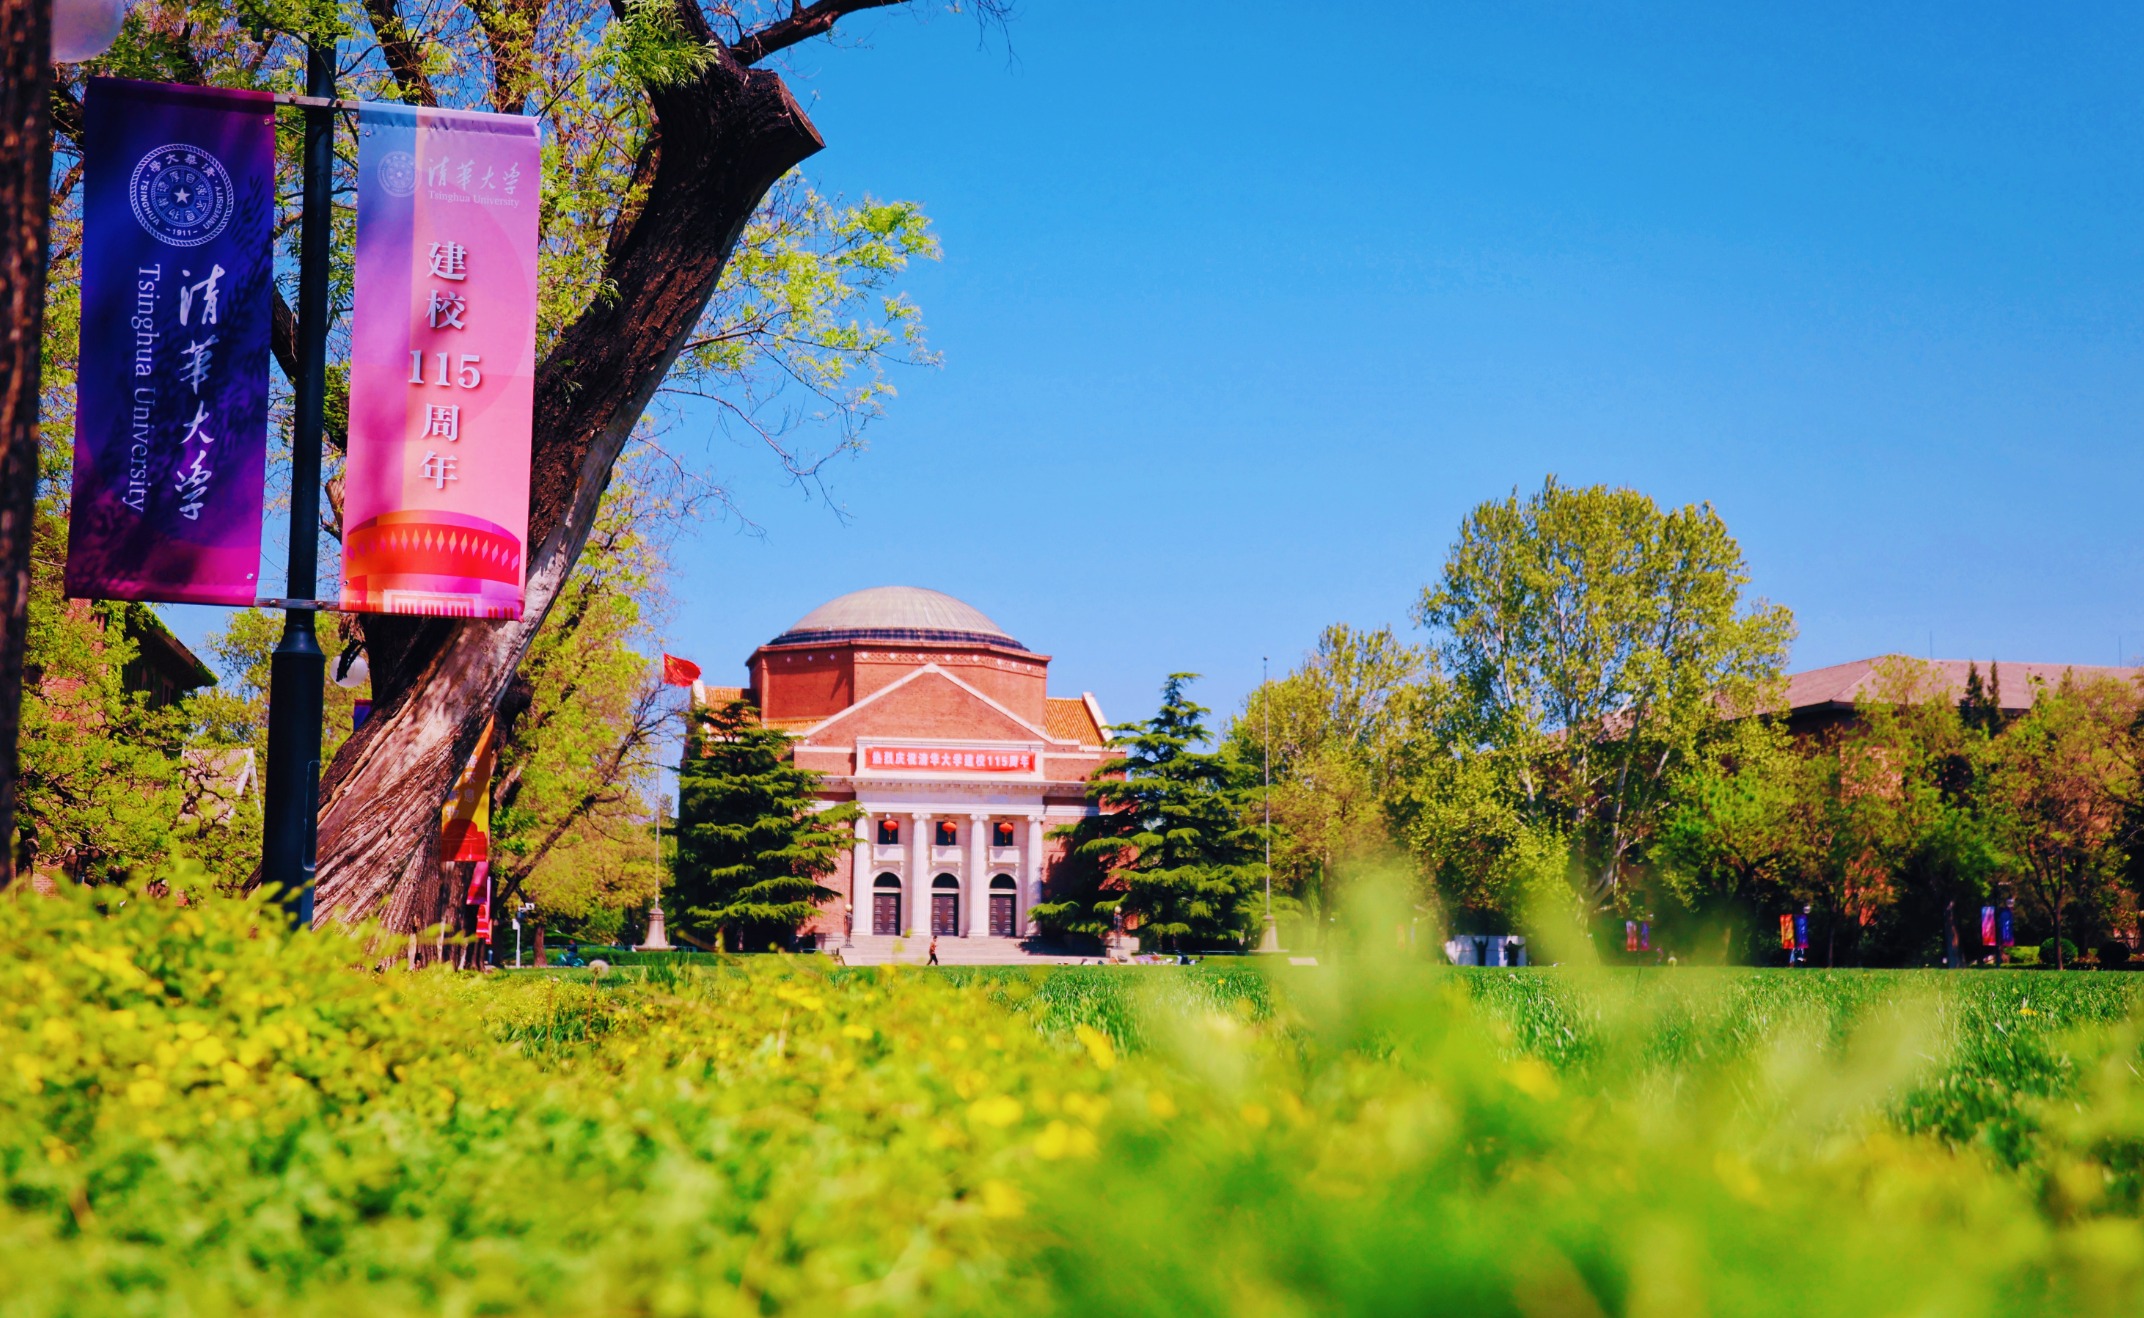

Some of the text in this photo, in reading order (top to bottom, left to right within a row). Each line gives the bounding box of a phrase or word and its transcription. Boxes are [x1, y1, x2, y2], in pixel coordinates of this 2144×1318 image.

[140, 180, 224, 230] TSINGHUA UNIVERSITY
[427, 190, 520, 209] Tsinghua University
[122, 263, 160, 513] Tsinghua University
